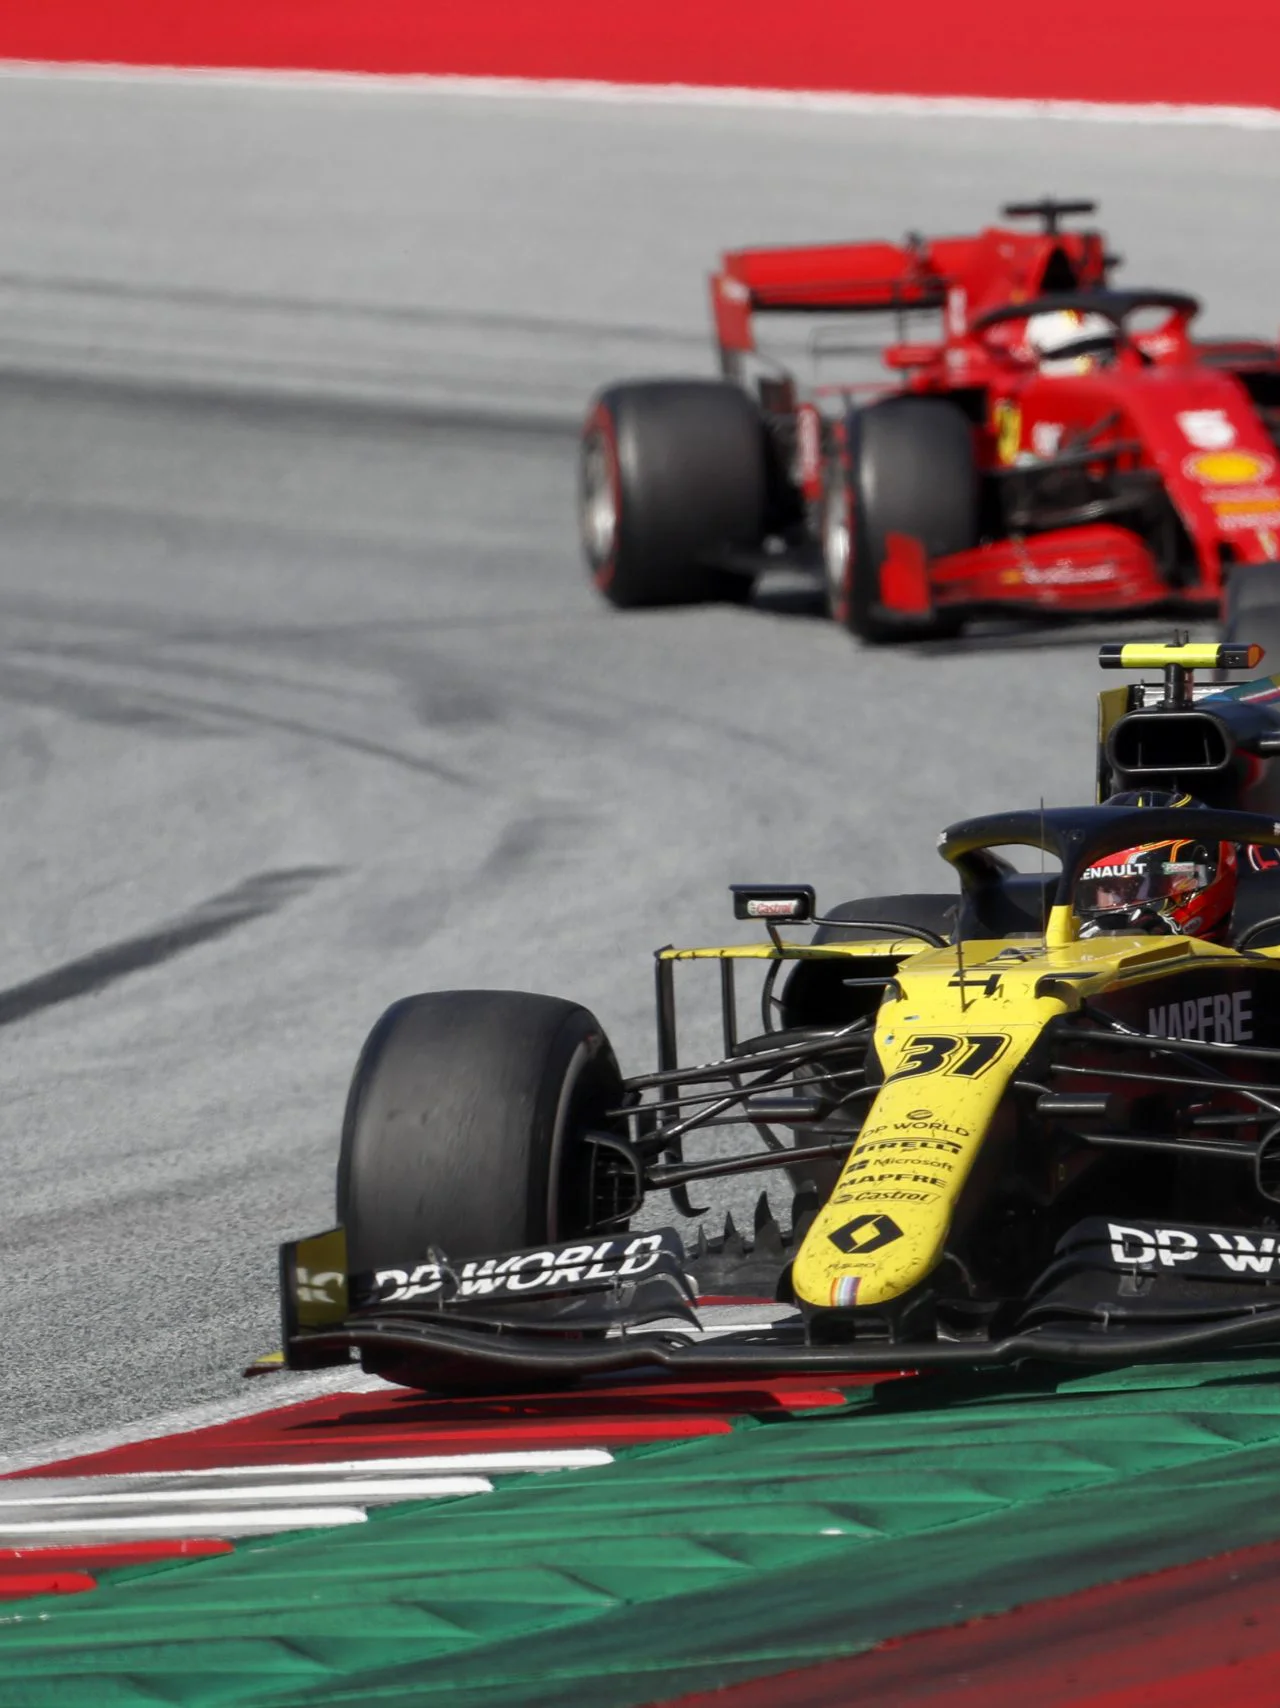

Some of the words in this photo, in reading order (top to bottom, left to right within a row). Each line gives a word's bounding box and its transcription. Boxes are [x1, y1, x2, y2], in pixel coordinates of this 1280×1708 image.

[1080, 862, 1146, 881] ENAULT
[1148, 990, 1254, 1043] MAPFRE
[884, 1033, 1012, 1087] 31
[893, 1122, 971, 1137] WORLD
[853, 1137, 963, 1157] PIRELLI
[872, 1157, 955, 1172] Microsoft
[838, 1173, 947, 1189] MAPFRE
[854, 1190, 930, 1202] Castrol
[1107, 1223, 1199, 1267] DP
[374, 1262, 443, 1301] DP
[457, 1234, 664, 1296] WORLD
